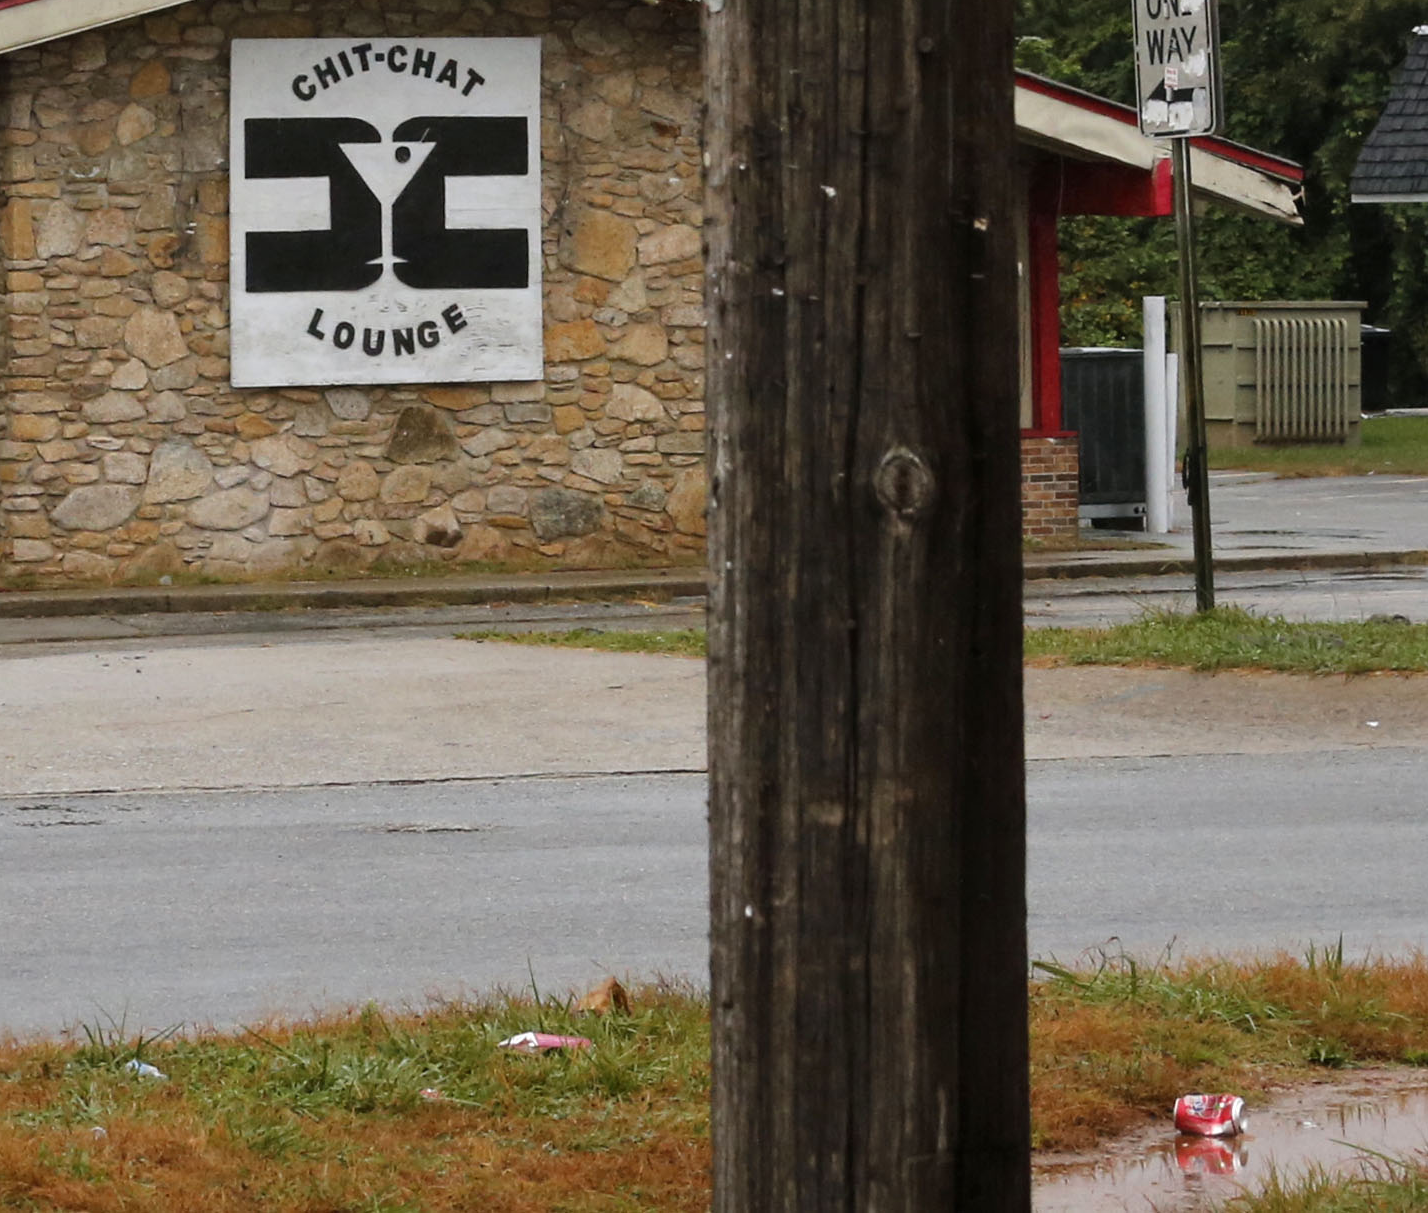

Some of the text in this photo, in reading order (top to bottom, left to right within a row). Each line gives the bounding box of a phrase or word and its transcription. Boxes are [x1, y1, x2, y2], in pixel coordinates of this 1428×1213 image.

[291, 42, 485, 102] CHIT-CHAT
[1146, 26, 1197, 66] WAY
[306, 303, 469, 357] LOUNGE
